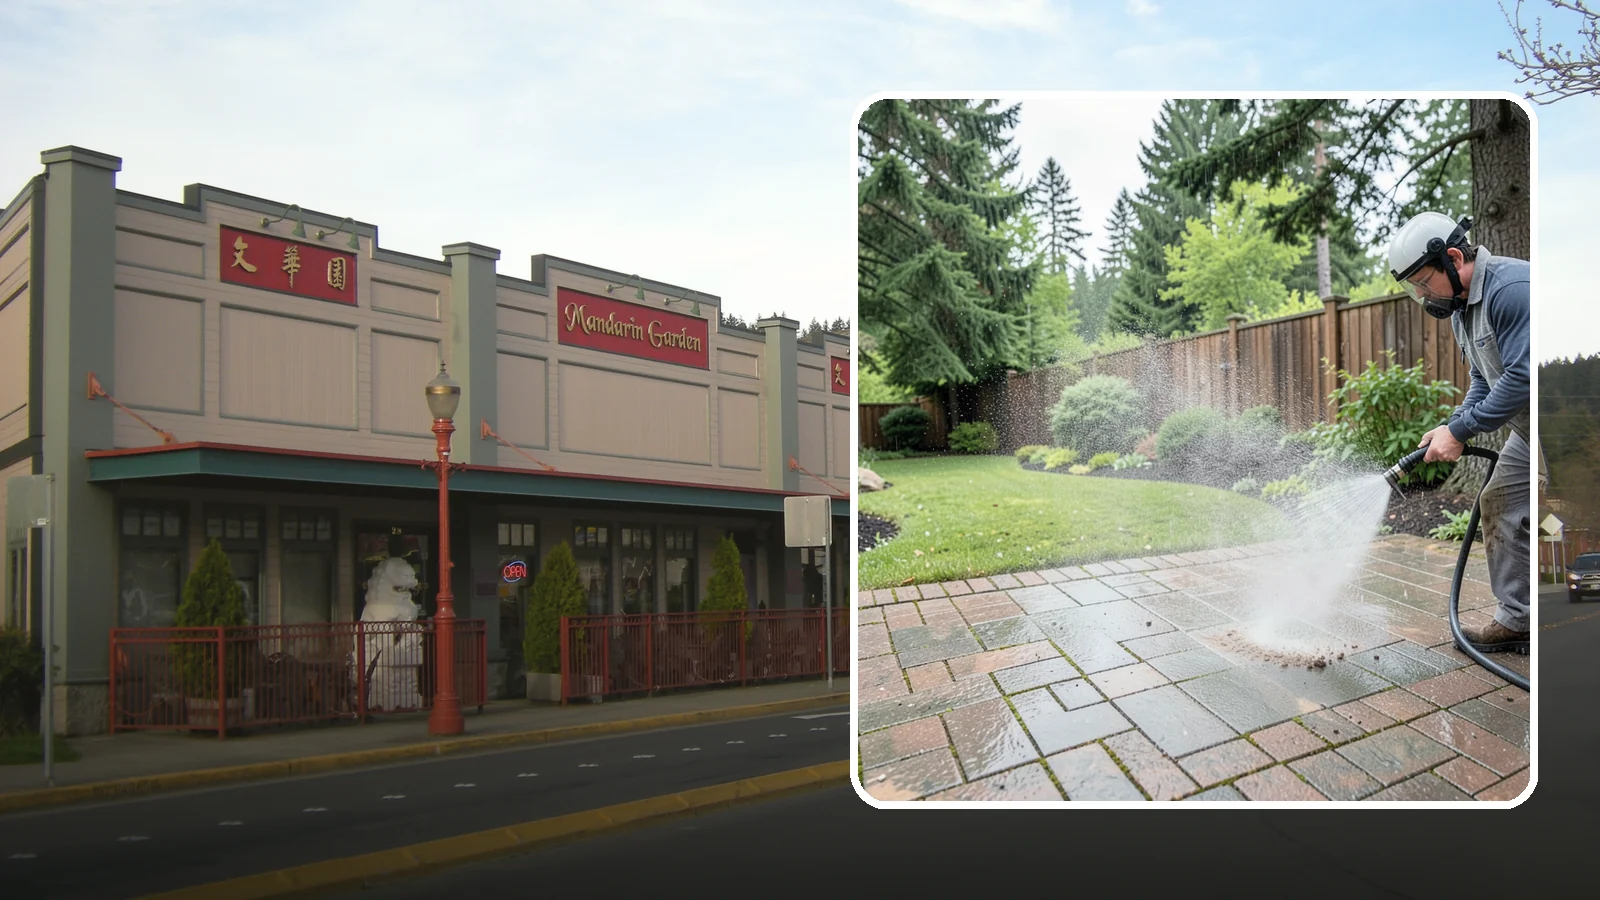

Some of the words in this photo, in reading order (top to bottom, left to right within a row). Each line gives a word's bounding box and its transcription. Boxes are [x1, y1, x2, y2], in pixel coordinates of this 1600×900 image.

[231, 235, 346, 291] 文華園
[564, 302, 644, 341] Mandarin
[647, 320, 702, 352] Garden
[835, 363, 847, 386] 文
[503, 565, 527, 578] OPEN
